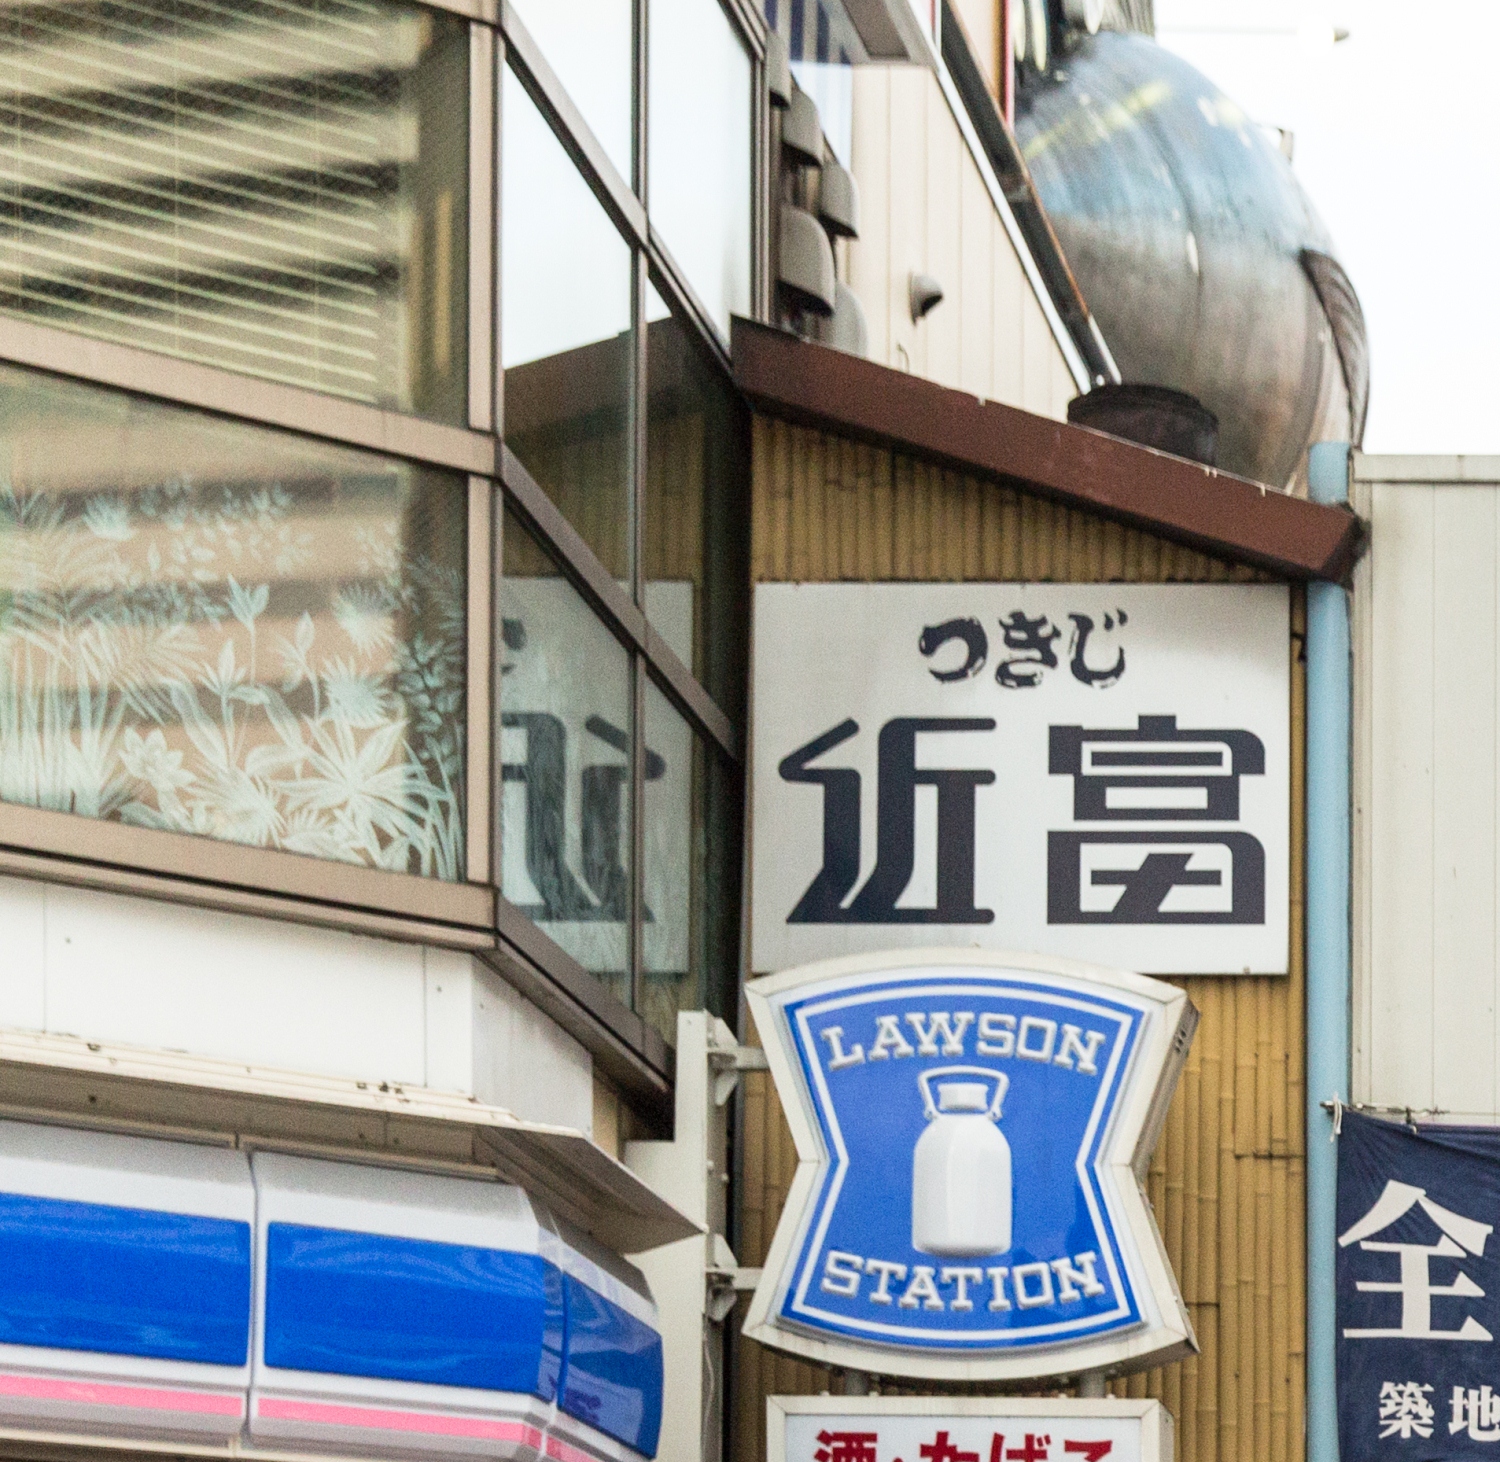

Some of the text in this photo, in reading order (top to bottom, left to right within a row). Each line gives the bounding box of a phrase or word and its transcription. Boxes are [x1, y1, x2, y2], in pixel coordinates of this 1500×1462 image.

[919, 608, 1128, 689] つきじ
[820, 1011, 1106, 1075] LAWSON
[820, 1250, 1106, 1313] STATION
